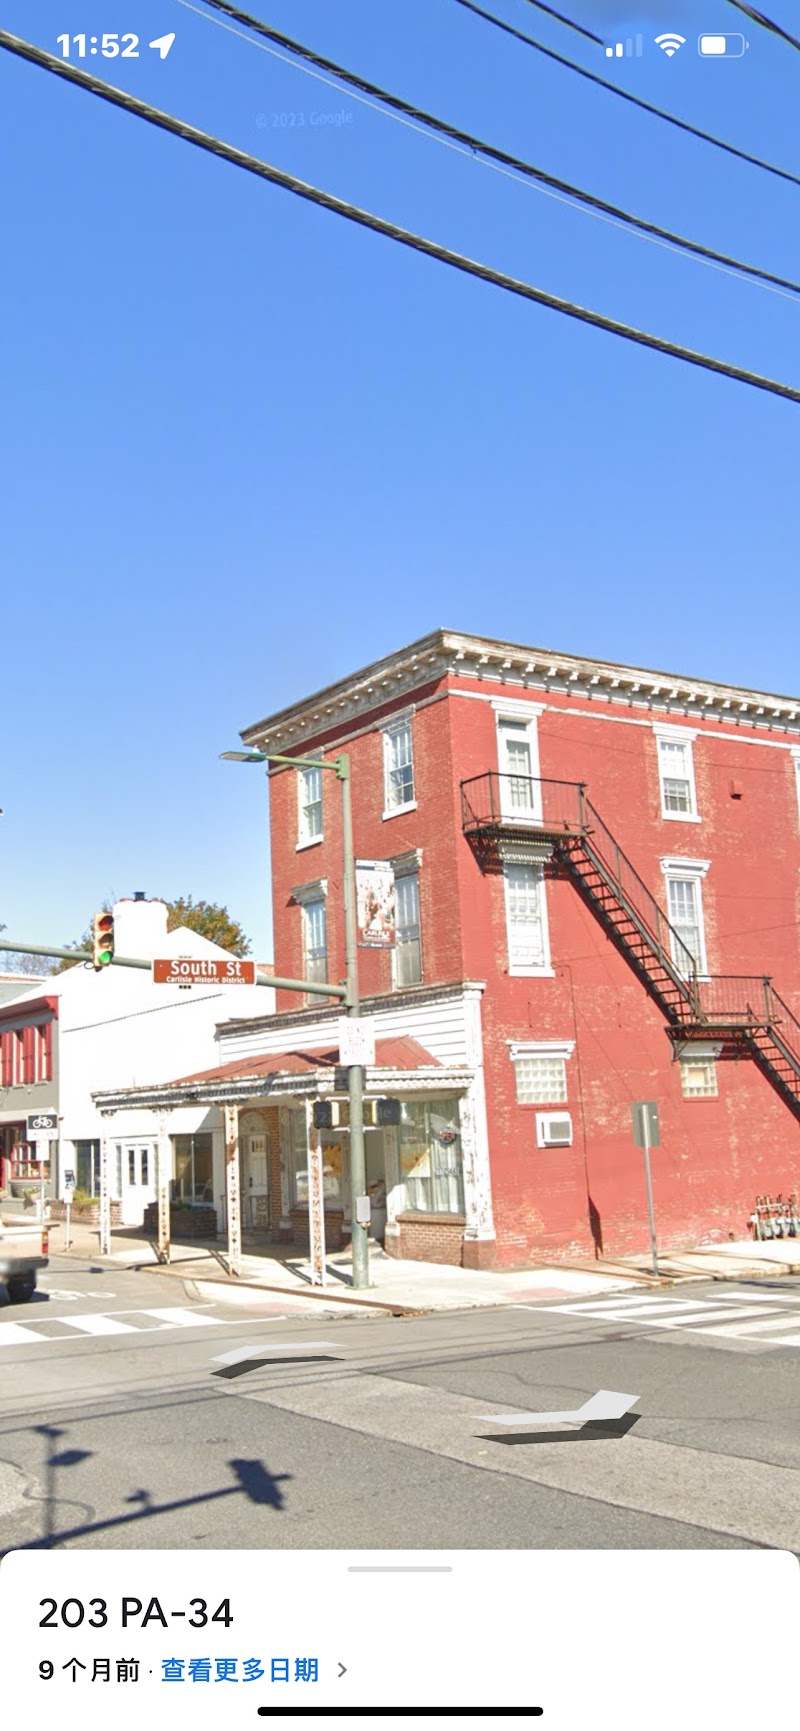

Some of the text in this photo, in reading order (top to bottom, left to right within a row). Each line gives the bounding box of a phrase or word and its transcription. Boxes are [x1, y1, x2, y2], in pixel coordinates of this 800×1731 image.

[170, 960, 242, 976] South St
[166, 975, 246, 984] Carlisle Historic District
